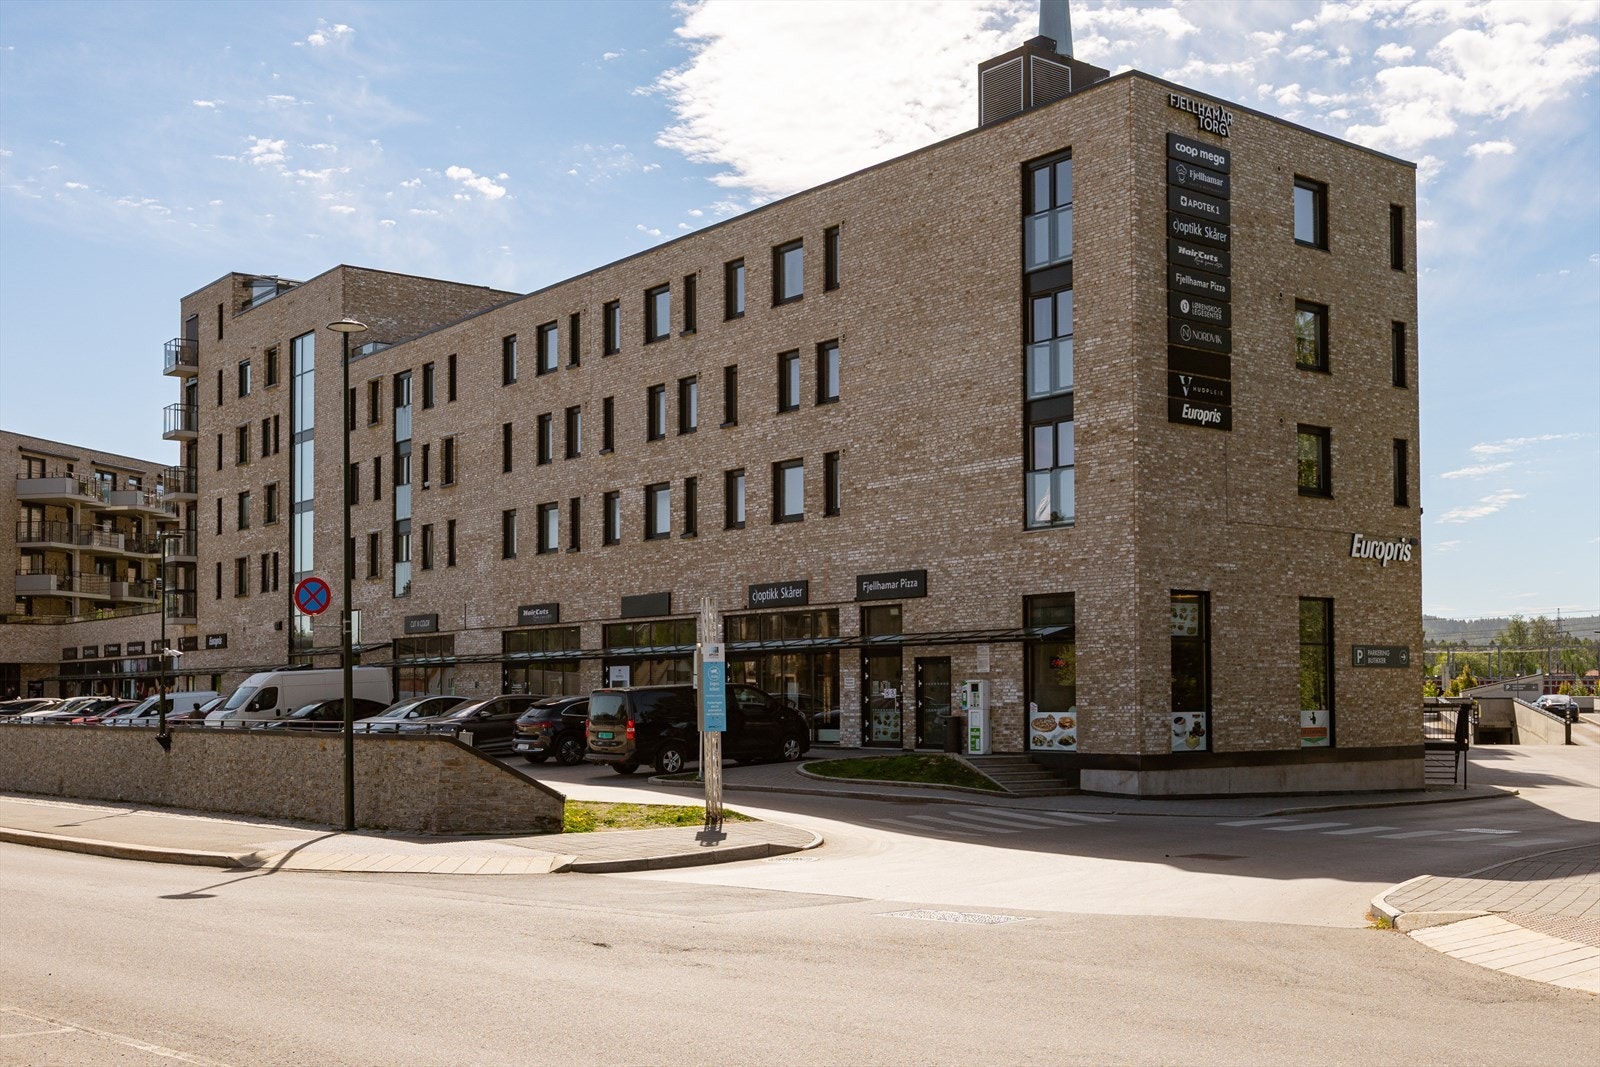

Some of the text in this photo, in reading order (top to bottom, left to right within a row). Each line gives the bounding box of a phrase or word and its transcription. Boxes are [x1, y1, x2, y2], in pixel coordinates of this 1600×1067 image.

[1170, 93, 1233, 125] FJELLHAMAR
[1198, 115, 1227, 136] TORG
[1175, 143, 1225, 166] coop mega
[1189, 169, 1223, 187] Fjellhamar
[1188, 199, 1220, 215] APOTEK 1
[1204, 226, 1228, 242] Skårer
[1175, 272, 1226, 292] Fjellhamar Pizza
[1192, 329, 1223, 344] NORDVIK
[1192, 386, 1223, 396] HUDPLEIE
[1182, 403, 1222, 425] Europris
[1351, 533, 1412, 567] Europris
[780, 586, 803, 599] Skårer
[862, 578, 918, 594] Fjellhamar Pizza
[1357, 649, 1364, 663] P
